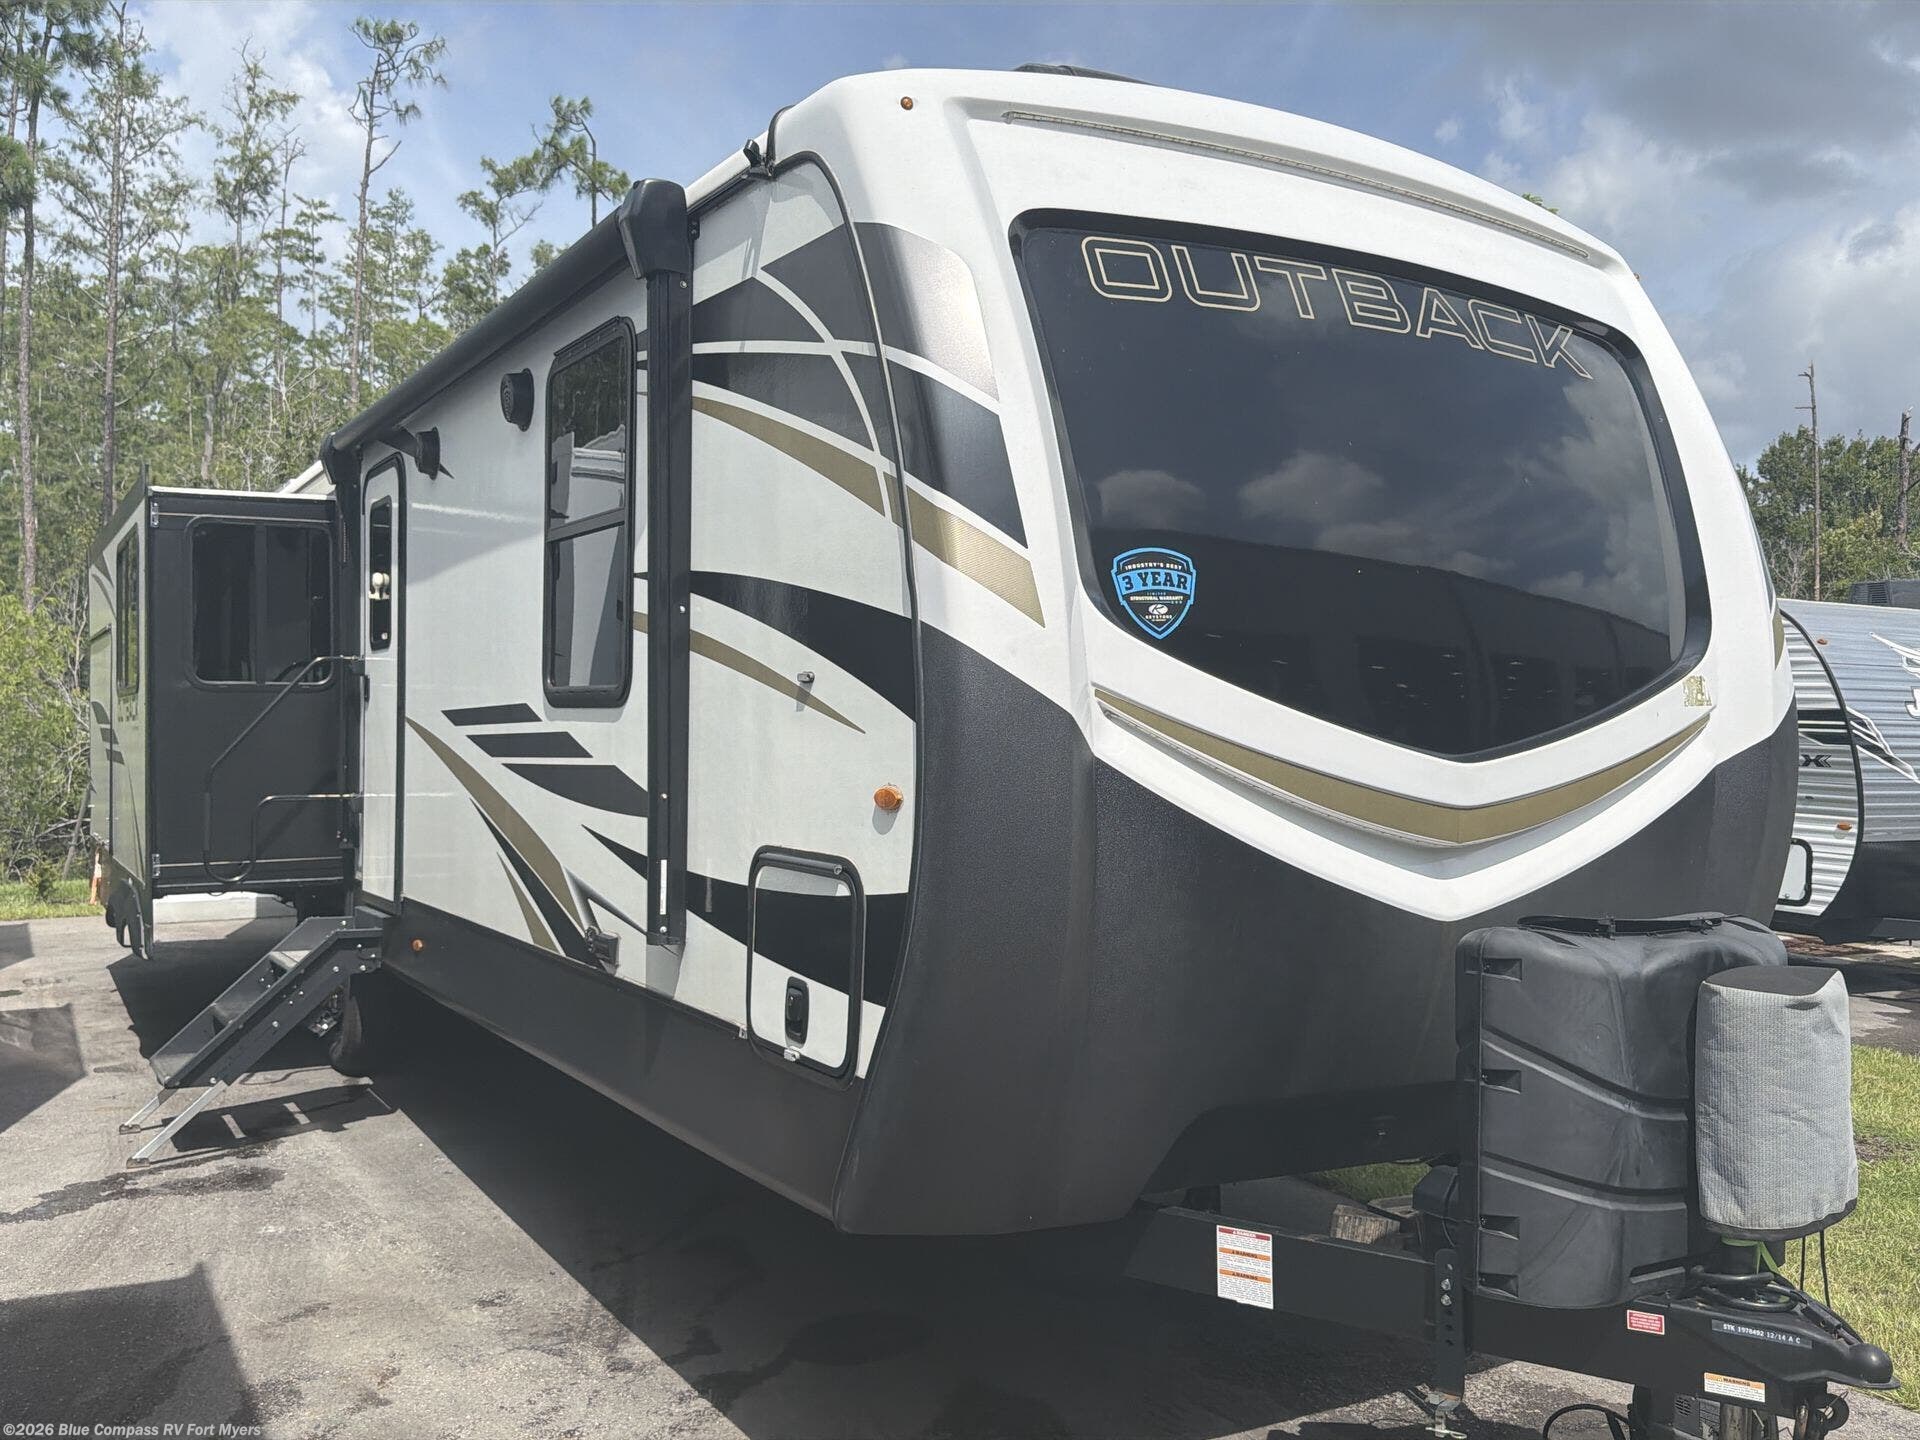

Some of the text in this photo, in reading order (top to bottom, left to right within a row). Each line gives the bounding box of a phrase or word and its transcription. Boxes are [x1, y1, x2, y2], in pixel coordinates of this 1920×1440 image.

[1081, 235, 1593, 380] OUTBACK
[1125, 562, 1182, 570] INDUSTRY'S BEST
[1122, 571, 1188, 591] 3 YEAR
[1766, 1331, 1786, 1341] 12/14
[1723, 1377, 1751, 1387] WARNING
